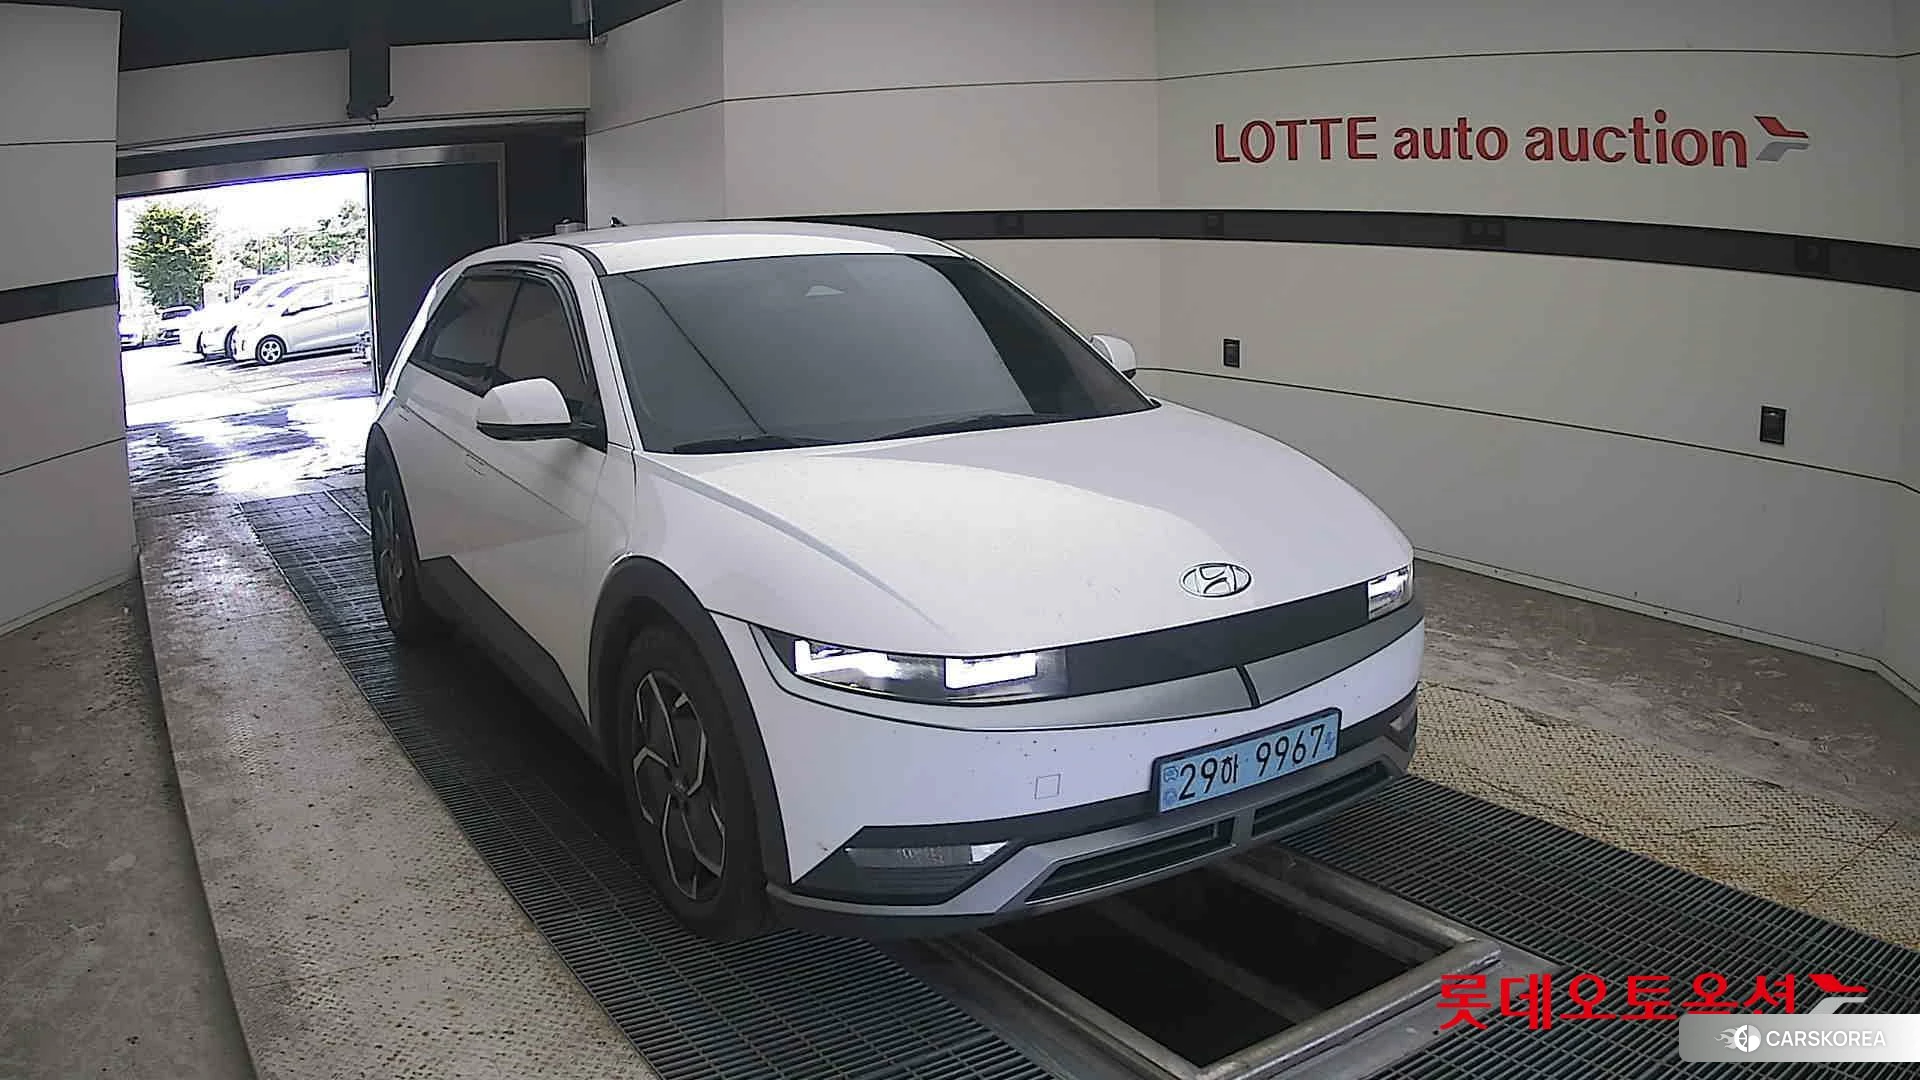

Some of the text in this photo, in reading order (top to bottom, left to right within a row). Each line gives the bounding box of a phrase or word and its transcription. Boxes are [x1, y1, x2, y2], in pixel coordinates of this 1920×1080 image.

[1215, 110, 1748, 168] LOTTE auto auction
[1178, 723, 1326, 801] 29하 9967
